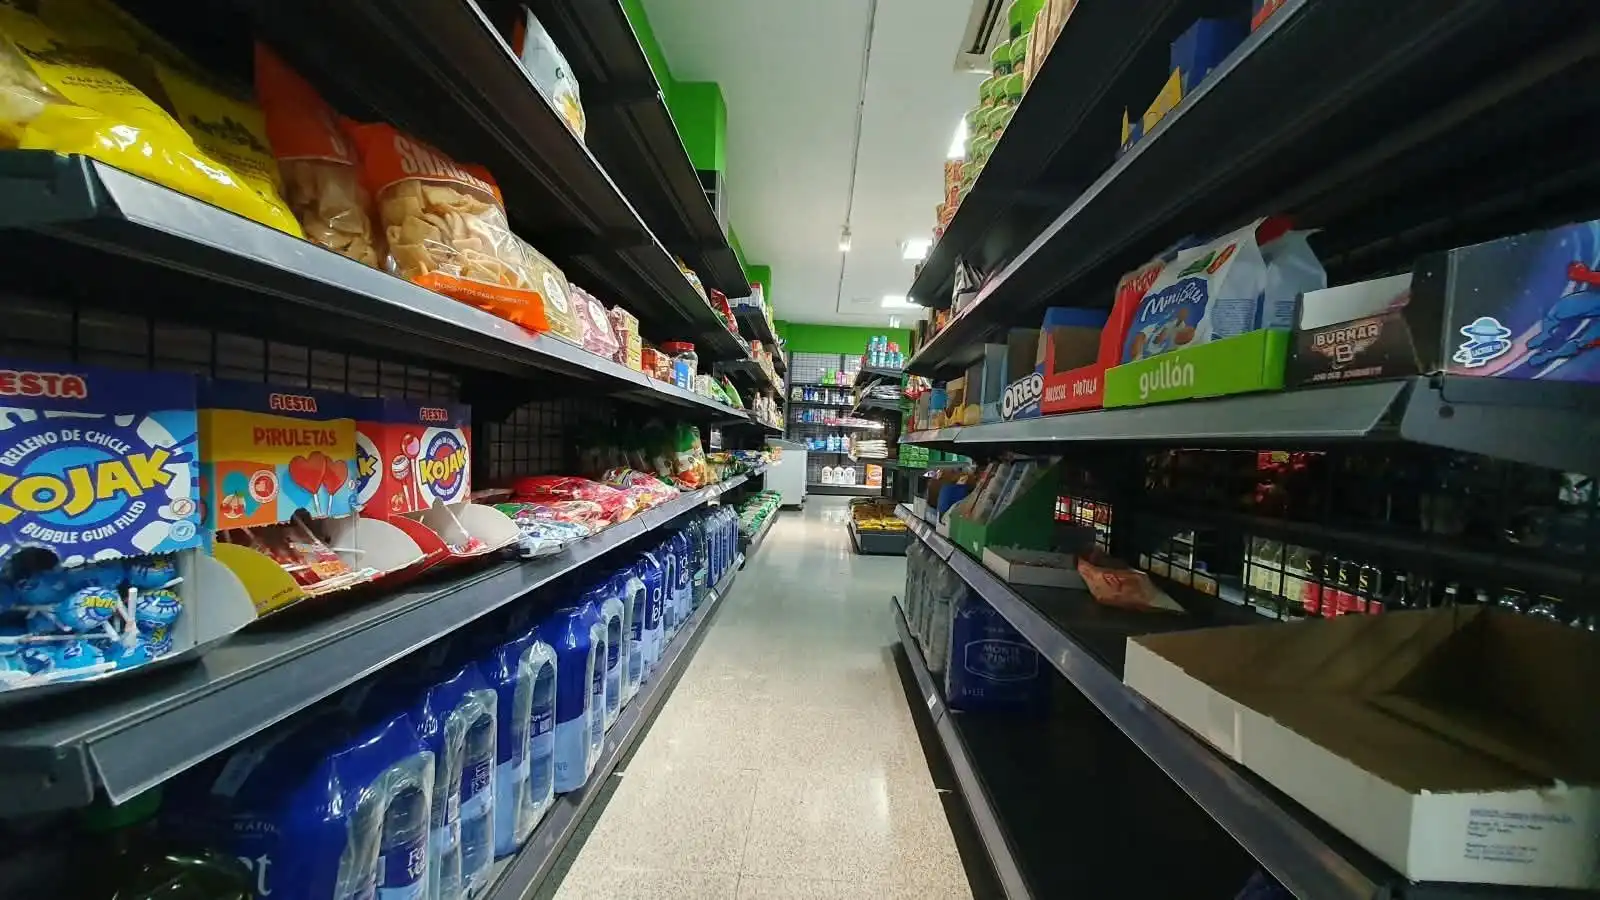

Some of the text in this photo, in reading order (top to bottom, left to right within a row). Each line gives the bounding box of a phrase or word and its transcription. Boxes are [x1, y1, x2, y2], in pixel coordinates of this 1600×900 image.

[1002, 373, 1043, 419] OREO
[1139, 355, 1195, 400] gullón
[269, 393, 318, 413] FIESTA
[420, 407, 448, 421] FIESTA
[0, 429, 131, 467] RELLENO DE CHICLE
[419, 445, 467, 485] KOJAK
[20, 500, 147, 544] BUBBLE GUM FILLED
